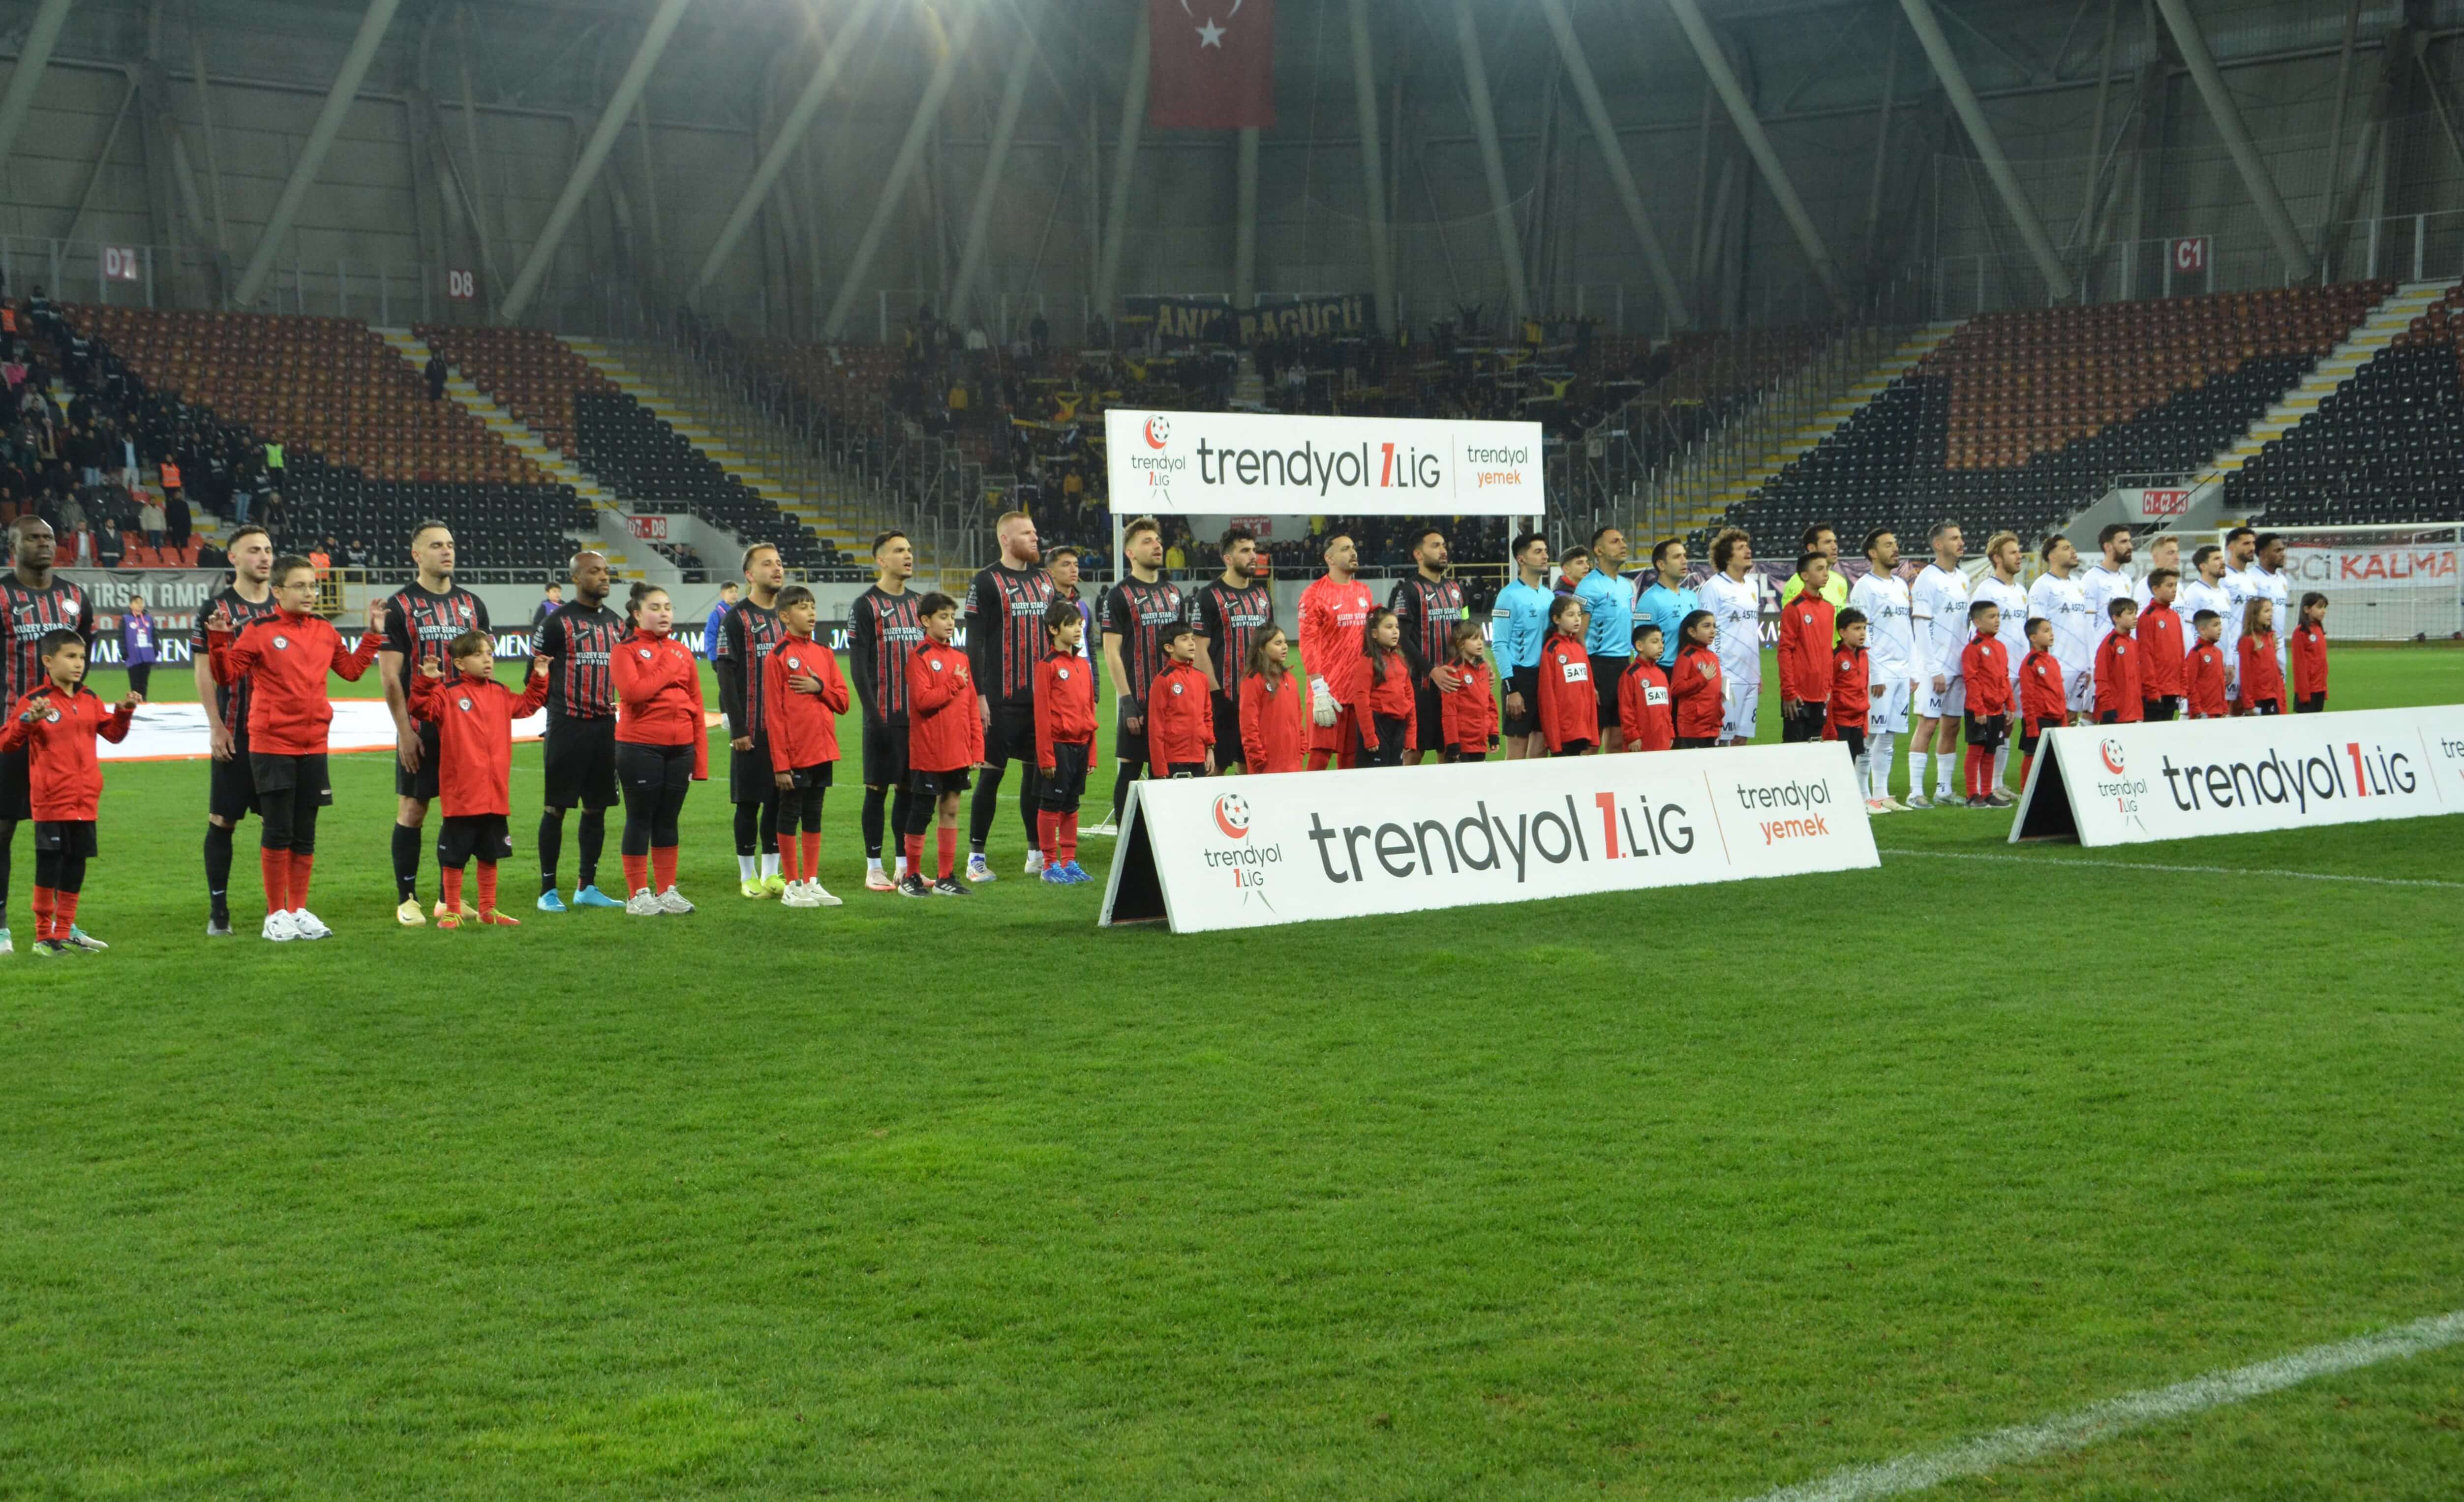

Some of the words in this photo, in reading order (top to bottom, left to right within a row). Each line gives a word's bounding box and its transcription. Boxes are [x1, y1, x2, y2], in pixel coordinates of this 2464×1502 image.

[2178, 240, 2201, 268] C1
[450, 270, 473, 297] D8
[1131, 454, 1186, 473] trendyol
[1196, 437, 1369, 496] trendyol
[1467, 445, 1528, 467] trendyol
[1477, 470, 1521, 488] yemek
[2144, 493, 2154, 512] C1
[2160, 493, 2171, 512] C2
[651, 519, 666, 537] D8
[418, 625, 440, 634] KUZEY
[441, 625, 457, 634] STAR
[2098, 778, 2147, 797] trendyol
[2162, 744, 2347, 814] trendyol
[1736, 778, 1831, 811] trendyol
[1308, 794, 1589, 884] trendyol
[1760, 813, 1829, 845] yemek
[1204, 843, 1282, 867] trendyol
